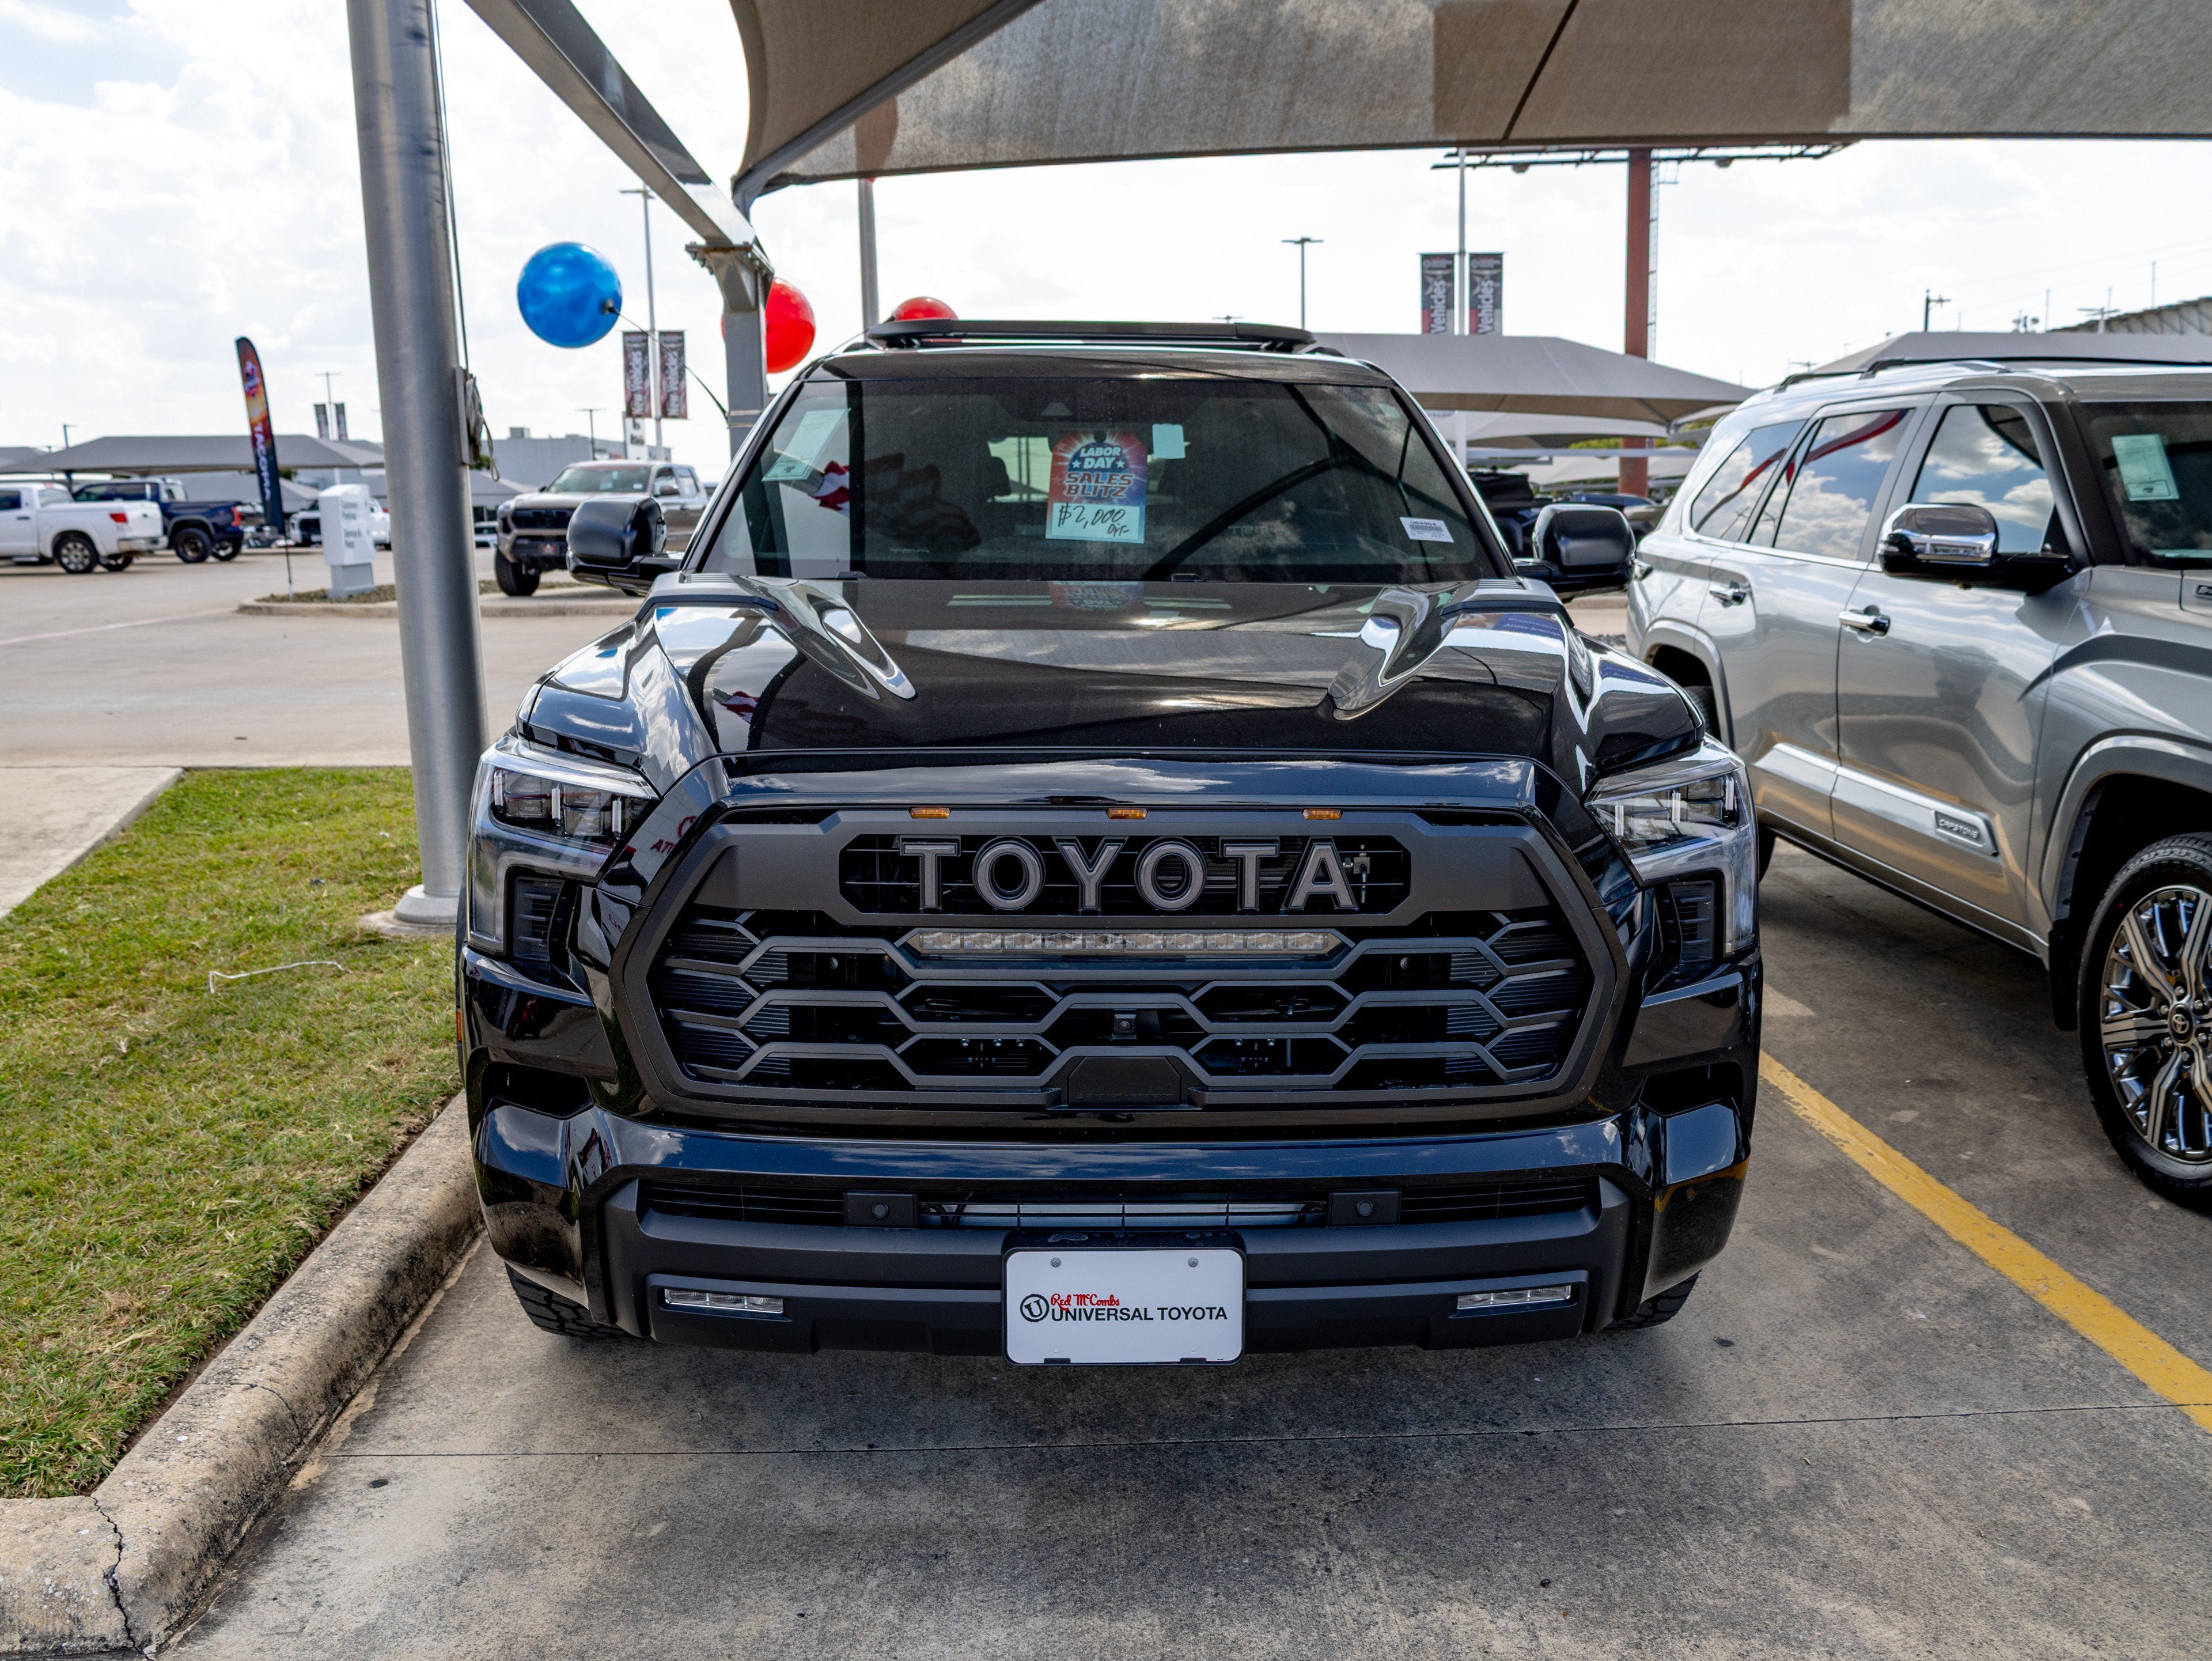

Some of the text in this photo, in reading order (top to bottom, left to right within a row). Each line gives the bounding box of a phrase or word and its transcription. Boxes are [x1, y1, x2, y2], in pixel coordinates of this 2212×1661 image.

[1430, 280, 1446, 334] Vehicles
[1477, 280, 1494, 334] Vehicles
[630, 351, 643, 392] Vehicles
[666, 351, 679, 393] Vehicles
[632, 393, 643, 415] New
[668, 394, 680, 415] New
[254, 423, 271, 501] TACOMA
[1080, 447, 1121, 457] LABOR
[1083, 457, 1116, 469] DAY
[1065, 472, 1133, 486] SALES
[1065, 484, 1126, 497] BLITZ
[1058, 503, 1126, 529] $2,000
[1940, 819, 1979, 838] CAPSTONE
[899, 835, 1358, 911] TOYOTA
[1050, 1293, 1119, 1311] Red McCombs
[1051, 1307, 1228, 1321] UNIVERSAL TOYOTA
